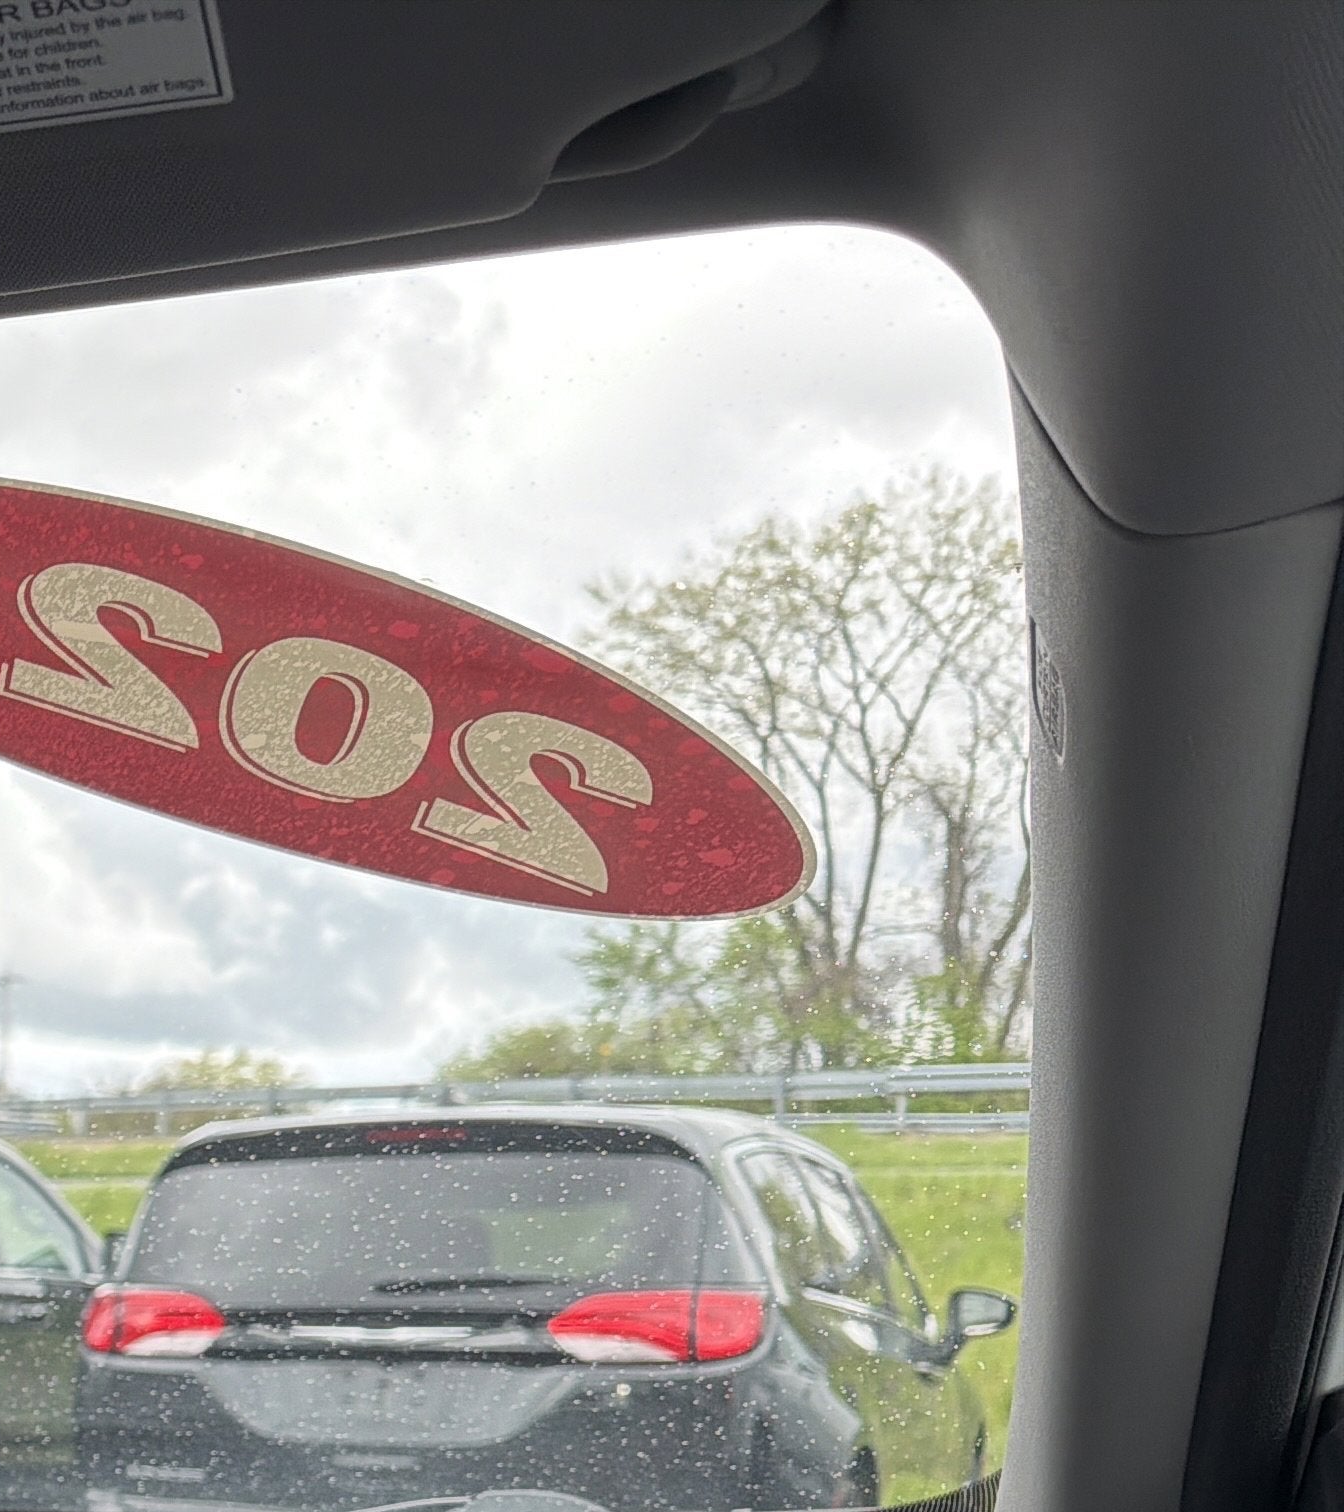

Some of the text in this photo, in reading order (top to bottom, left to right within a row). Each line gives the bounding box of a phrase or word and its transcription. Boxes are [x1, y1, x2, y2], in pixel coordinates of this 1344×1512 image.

[11, 24, 67, 45] injured
[71, 19, 90, 35] by
[95, 14, 121, 31] the
[8, 46, 30, 60] for
[16, 64, 32, 77] in
[35, 60, 61, 75] the
[89, 85, 136, 103] about
[140, 81, 161, 96] air
